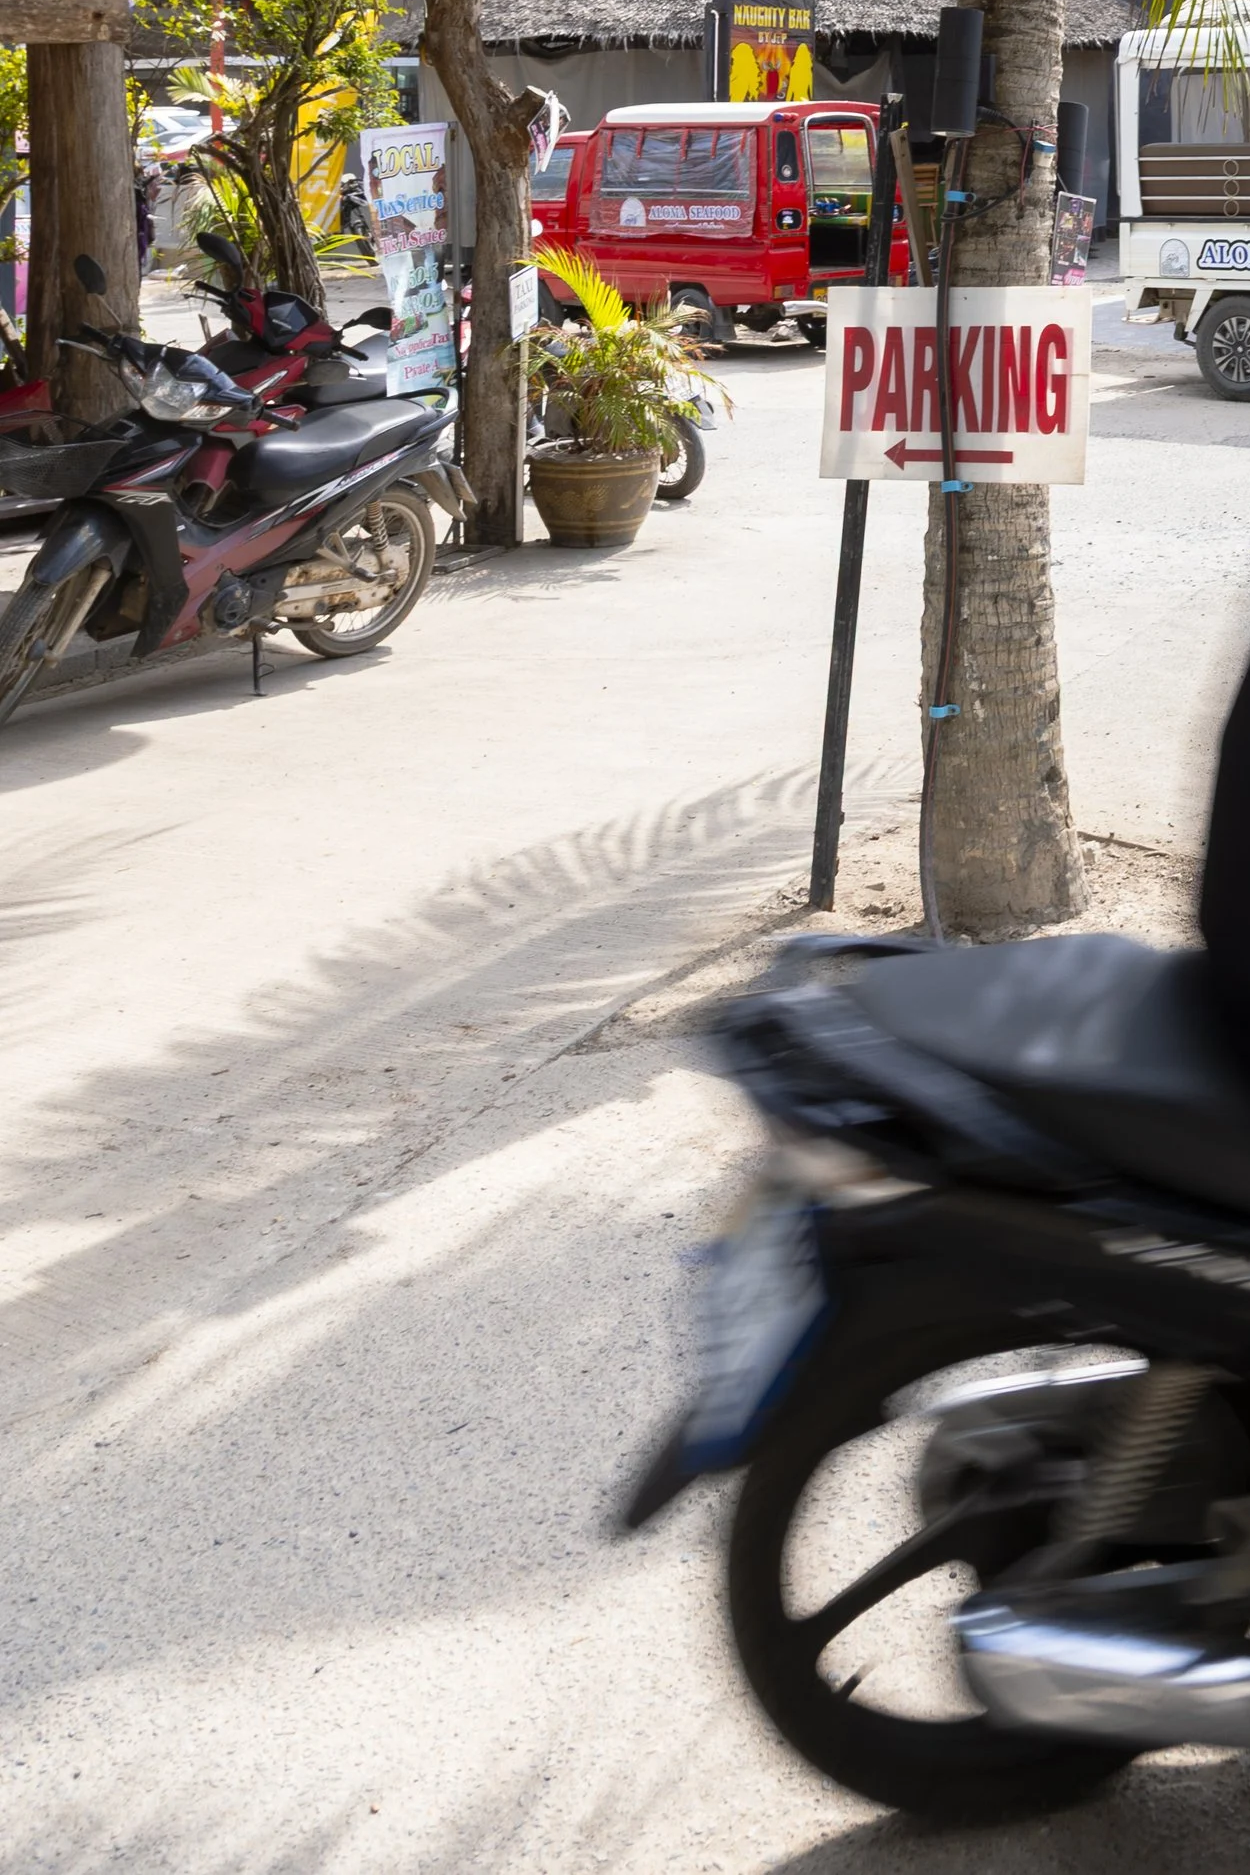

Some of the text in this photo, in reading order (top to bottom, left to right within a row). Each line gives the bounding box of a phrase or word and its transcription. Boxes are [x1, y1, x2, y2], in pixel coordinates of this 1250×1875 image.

[733, 5, 811, 30] NAUGHTY BAR
[373, 142, 440, 180] LOCAL
[649, 205, 741, 221] ALOMA SEAFOOD
[839, 323, 1069, 435] PARKING
